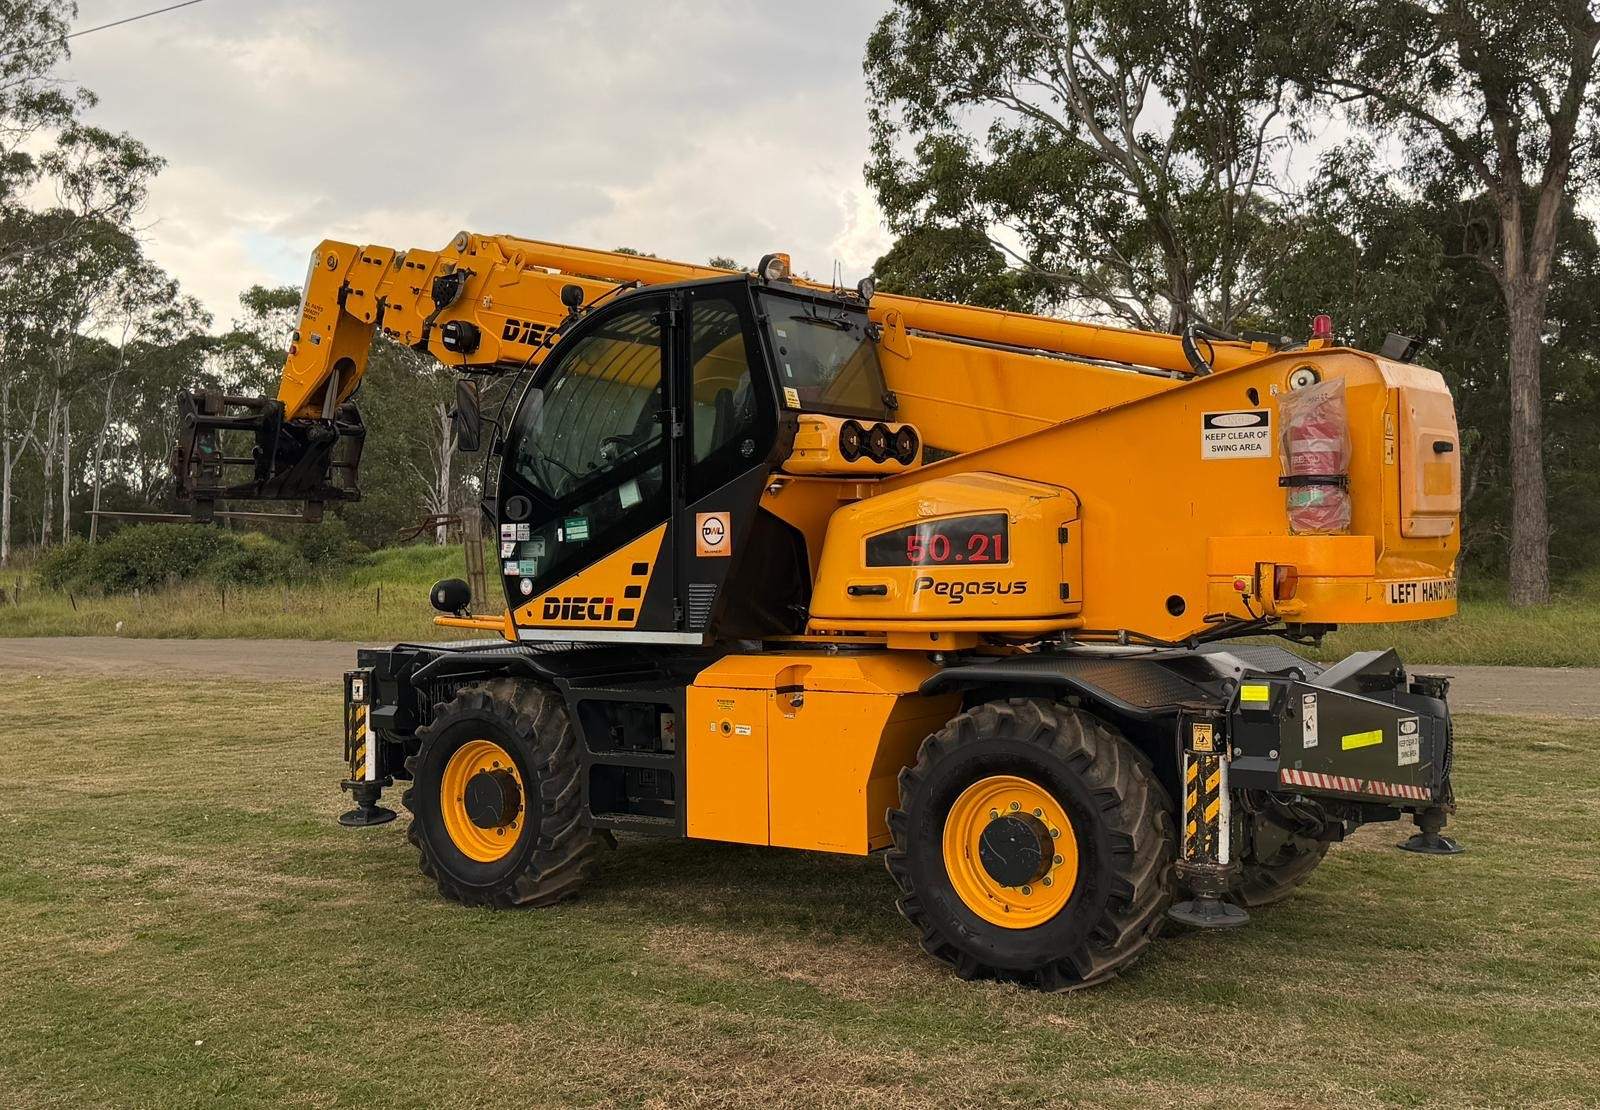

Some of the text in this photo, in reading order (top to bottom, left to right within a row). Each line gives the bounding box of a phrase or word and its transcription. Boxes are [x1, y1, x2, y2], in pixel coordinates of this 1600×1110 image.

[502, 318, 561, 349] DIEC
[1205, 430, 1268, 441] KEEP CLEAR OF
[1211, 443, 1262, 453] SWING AREA
[906, 534, 1003, 562] 50.21
[913, 576, 1028, 605] Pegasus
[1391, 583, 1417, 604] LEFT
[1422, 581, 1442, 602] HAND
[542, 596, 615, 621] DIECI
